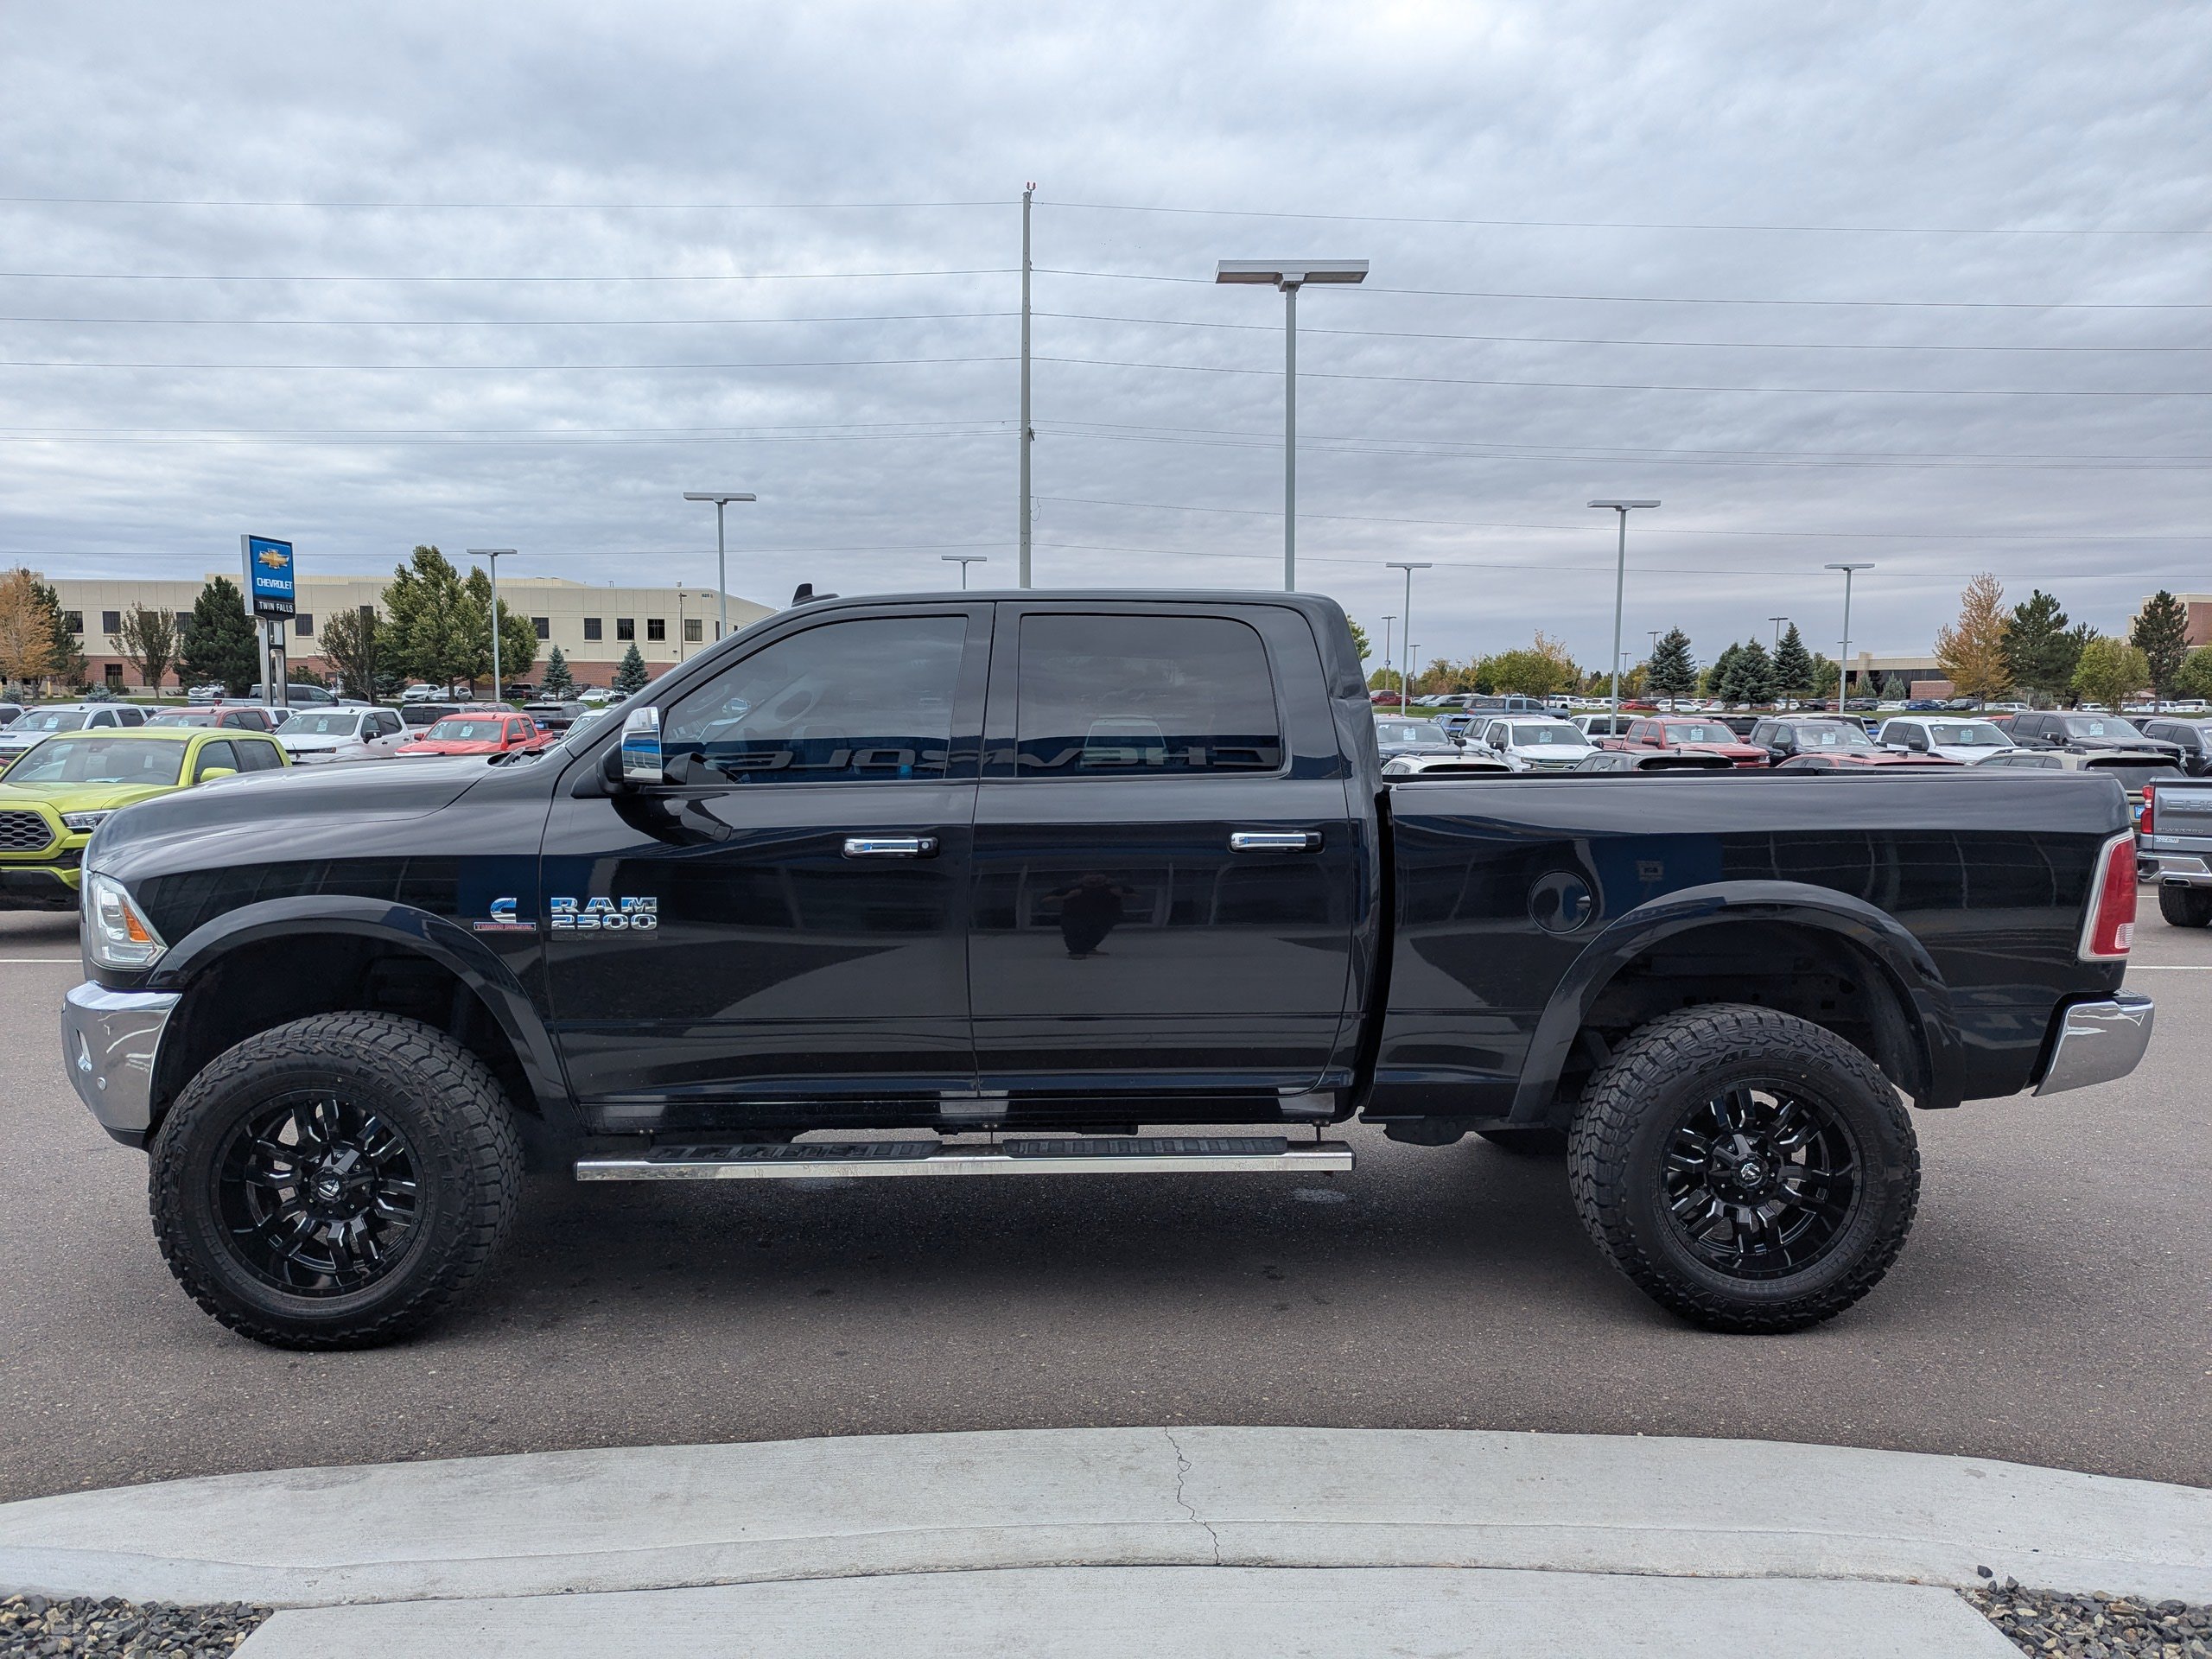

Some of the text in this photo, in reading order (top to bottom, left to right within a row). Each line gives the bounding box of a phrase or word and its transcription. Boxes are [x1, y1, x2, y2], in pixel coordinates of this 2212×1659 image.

[257, 577, 293, 590] CHEVROLET
[259, 601, 294, 613] TWIN FALLS
[550, 897, 658, 913] RAM
[550, 913, 658, 931] 2500
[1694, 1048, 1834, 1076] FALKEN
